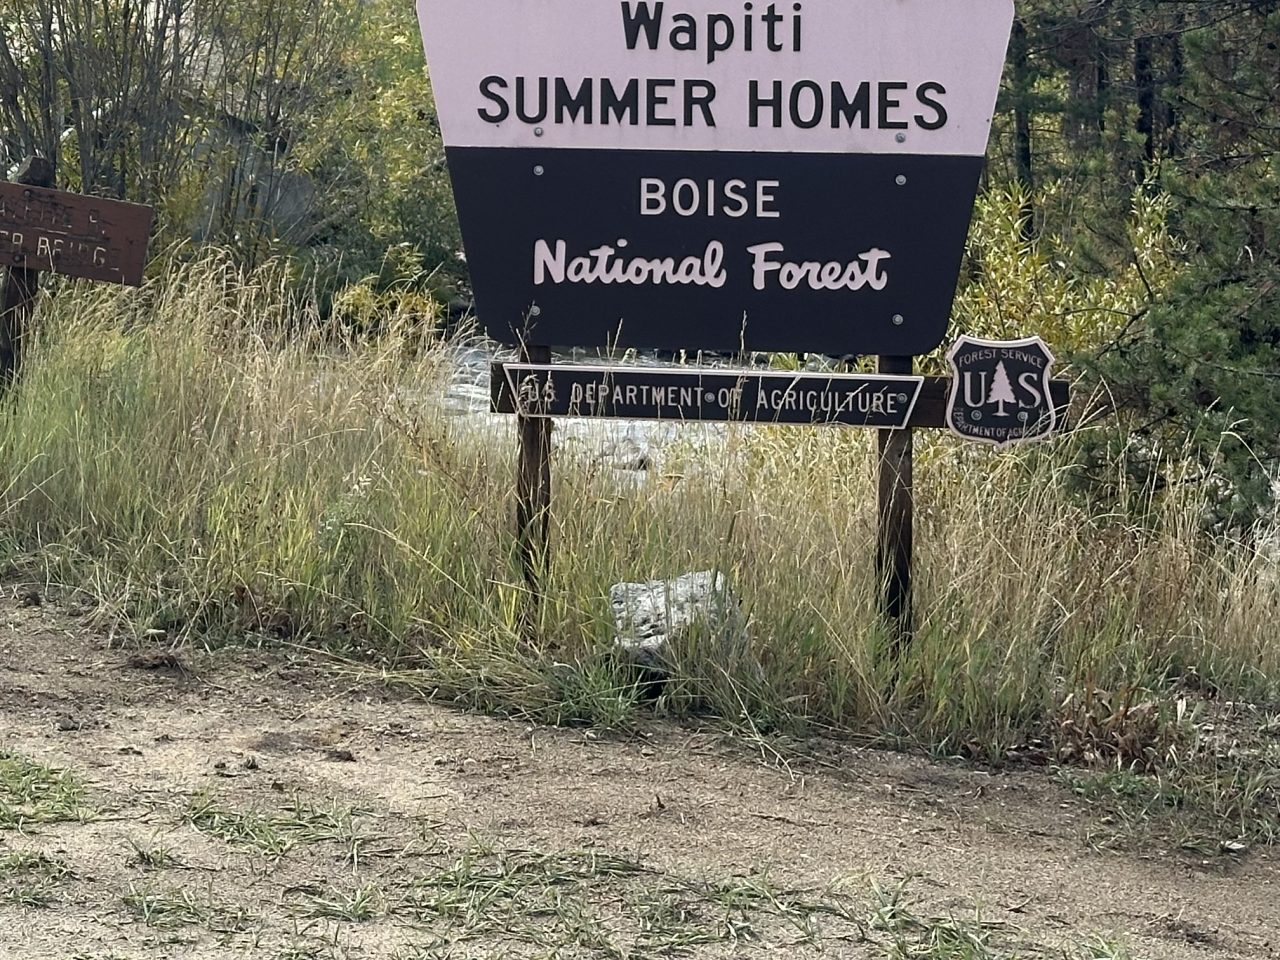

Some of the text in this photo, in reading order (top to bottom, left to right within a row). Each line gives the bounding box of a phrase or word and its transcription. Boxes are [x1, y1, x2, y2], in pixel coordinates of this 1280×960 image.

[620, 1, 802, 65] Wapiti
[477, 75, 948, 131] SUMMER HOMES
[640, 177, 780, 217] BOISE
[533, 238, 892, 290] National Forest
[959, 348, 1043, 369] FOREST SERVICE
[571, 383, 705, 407] DEPARTMENT
[757, 390, 898, 414] AGRICULTURE
